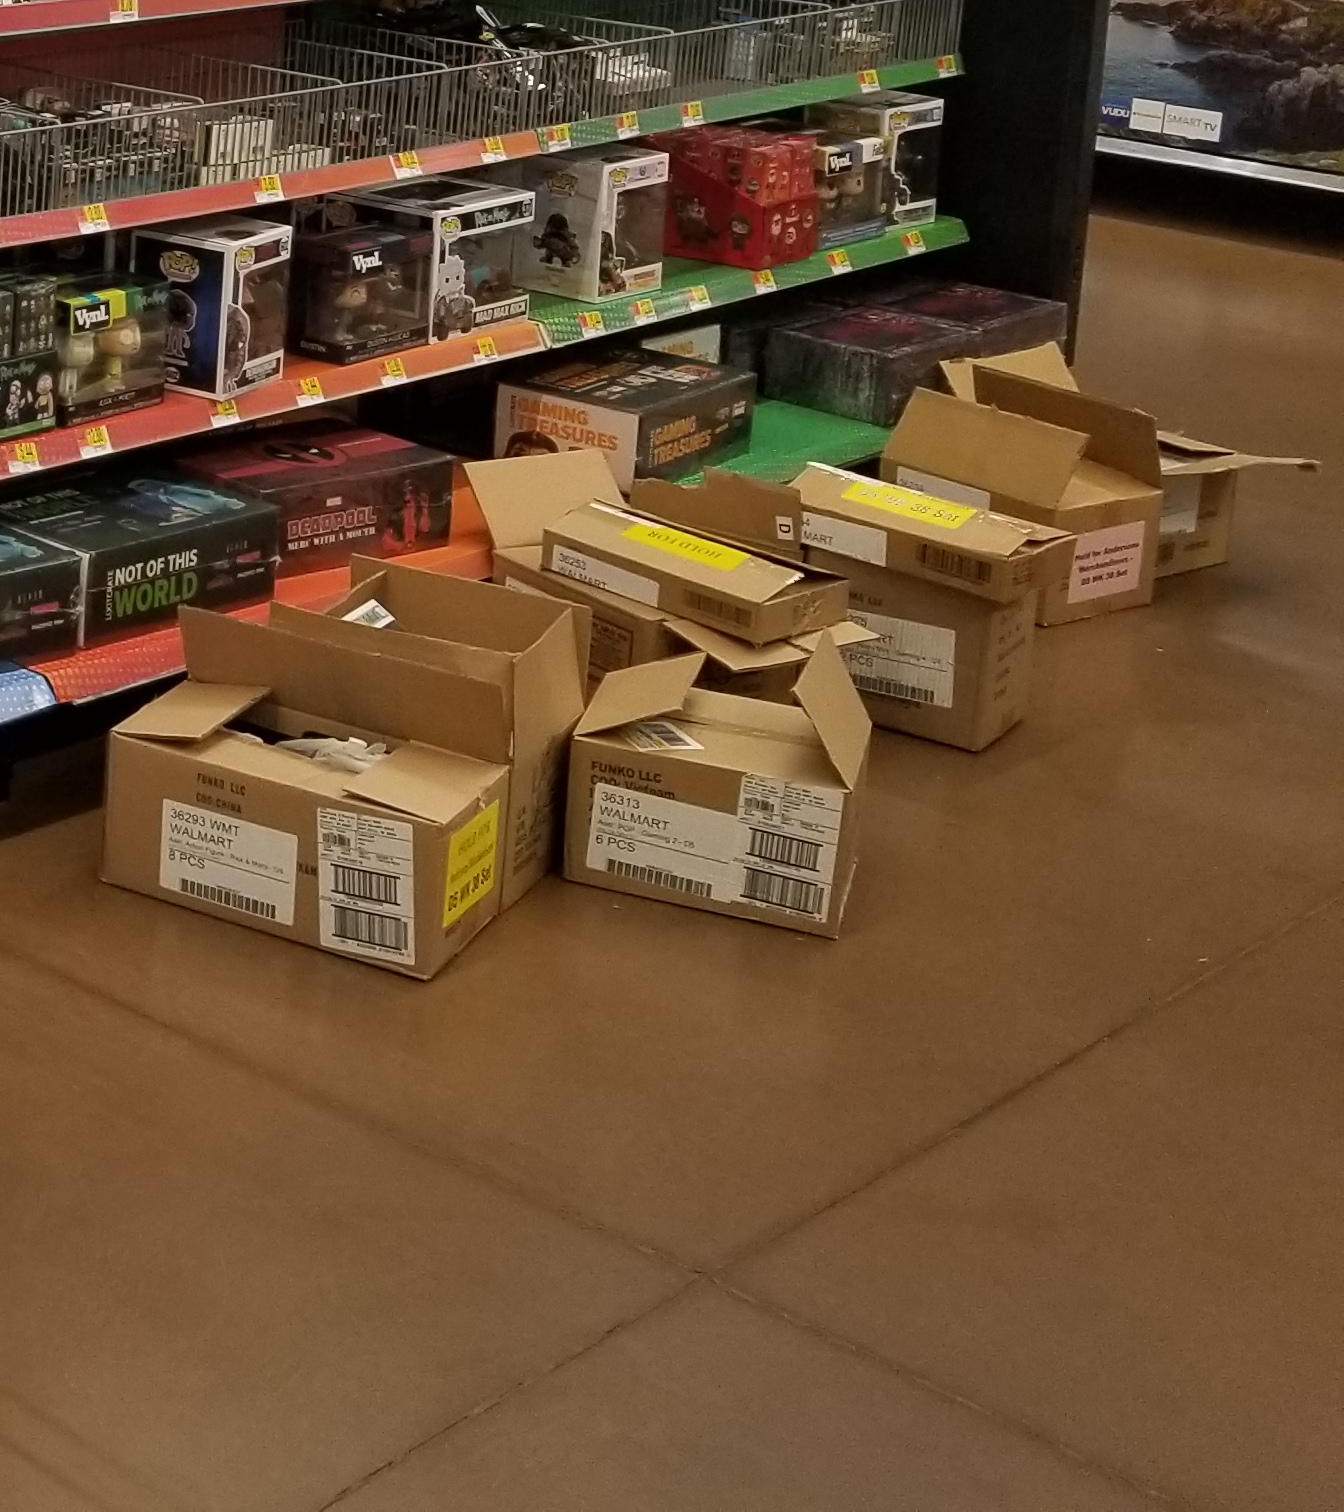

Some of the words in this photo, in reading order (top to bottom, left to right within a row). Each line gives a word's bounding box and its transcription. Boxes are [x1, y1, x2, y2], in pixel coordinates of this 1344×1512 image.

[1100, 105, 1130, 119] VUDU
[1166, 113, 1202, 128] SMART
[1203, 121, 1219, 133] TV
[518, 397, 590, 426] GAMING
[518, 414, 619, 451] TREASURES
[654, 415, 697, 443] GAMING
[654, 429, 712, 465] TREASURES
[288, 506, 378, 538] DEADPOOL
[115, 560, 144, 584] NOT
[146, 556, 166, 577] OF
[167, 549, 199, 572] THIS
[114, 571, 199, 618] WORLD
[591, 760, 635, 780] FUNKO
[638, 770, 662, 784] LLC
[600, 791, 641, 810] 36313
[169, 807, 207, 828] 36293
[211, 820, 241, 838] WMT
[599, 805, 671, 832] WALMART
[169, 822, 234, 849] WALMART
[595, 834, 604, 846] 6
[607, 836, 637, 853] PCS
[179, 853, 206, 870] PCS
